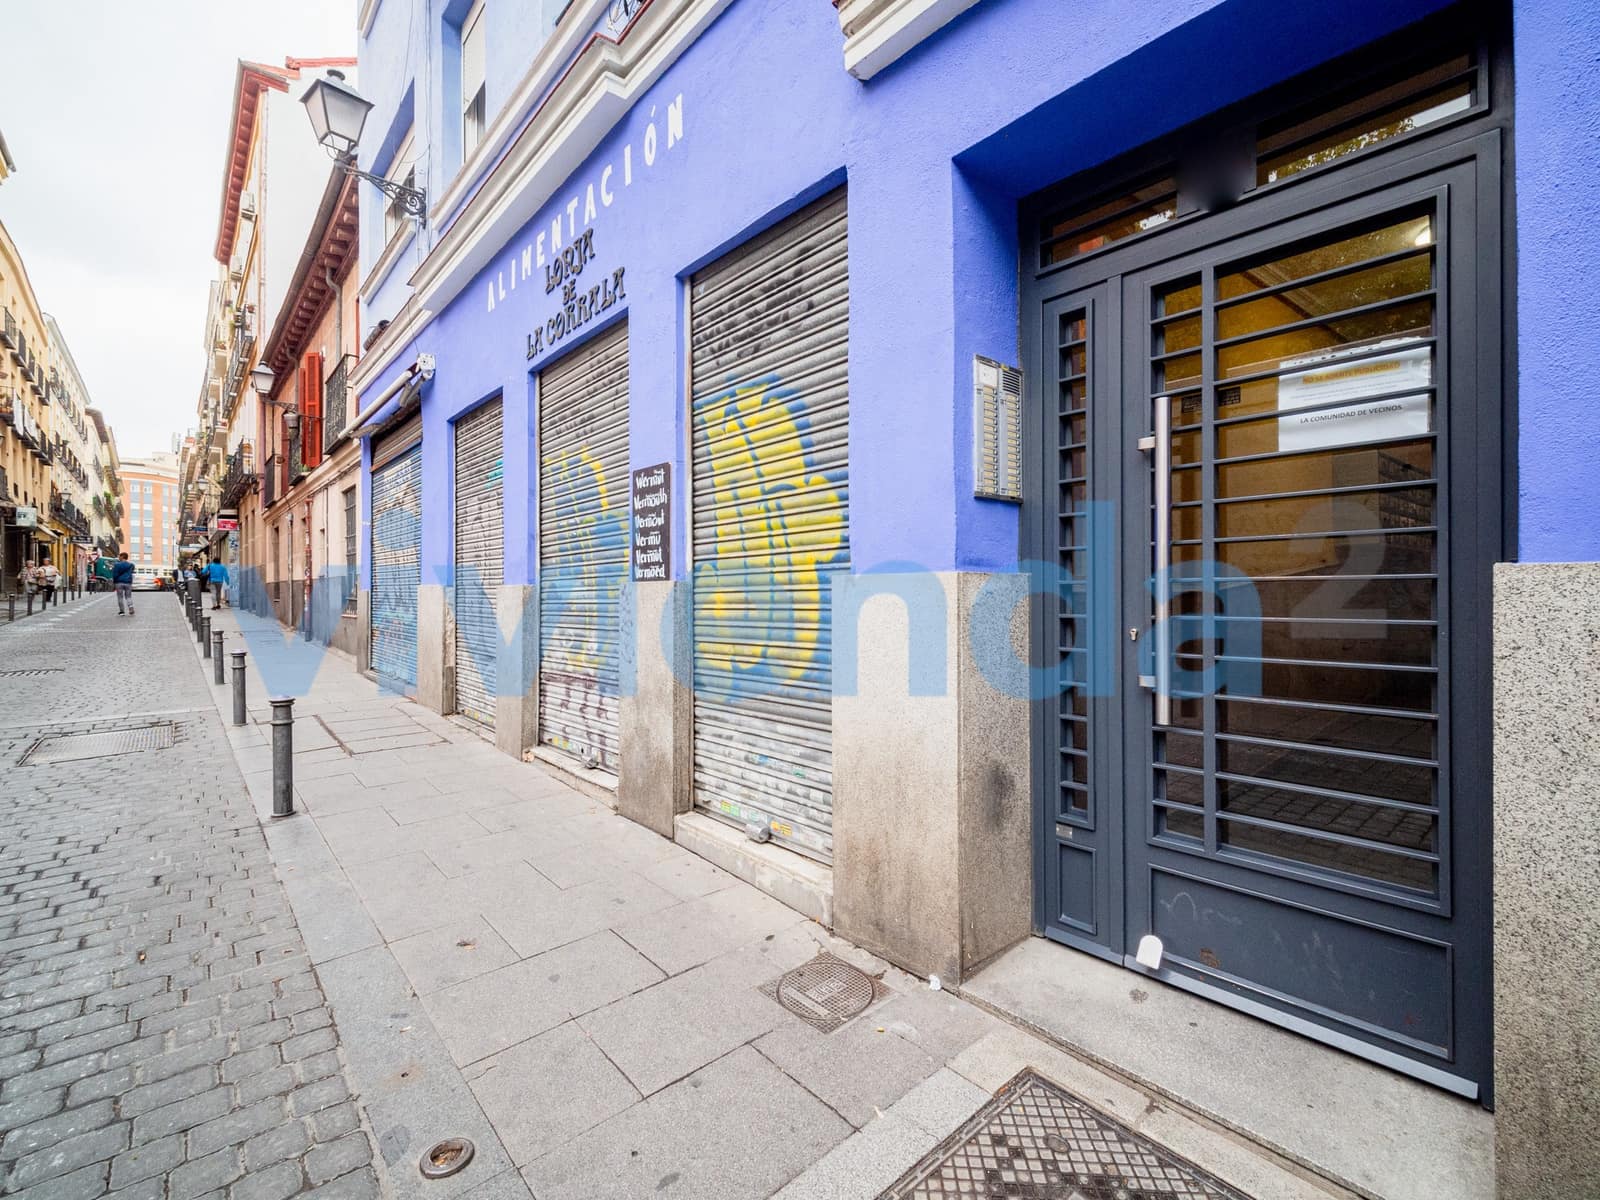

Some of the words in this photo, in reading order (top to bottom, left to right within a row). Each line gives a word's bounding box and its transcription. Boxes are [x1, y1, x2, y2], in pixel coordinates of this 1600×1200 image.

[487, 93, 684, 312] ALIMENTACIÓN
[526, 325, 544, 361] LA
[546, 266, 627, 346] CORRALA
[562, 279, 576, 306] DE
[1300, 416, 1309, 424] LA
[1310, 410, 1356, 423] COMUNIDAD
[1358, 408, 1368, 417] DE
[1369, 403, 1403, 415] VECINOS
